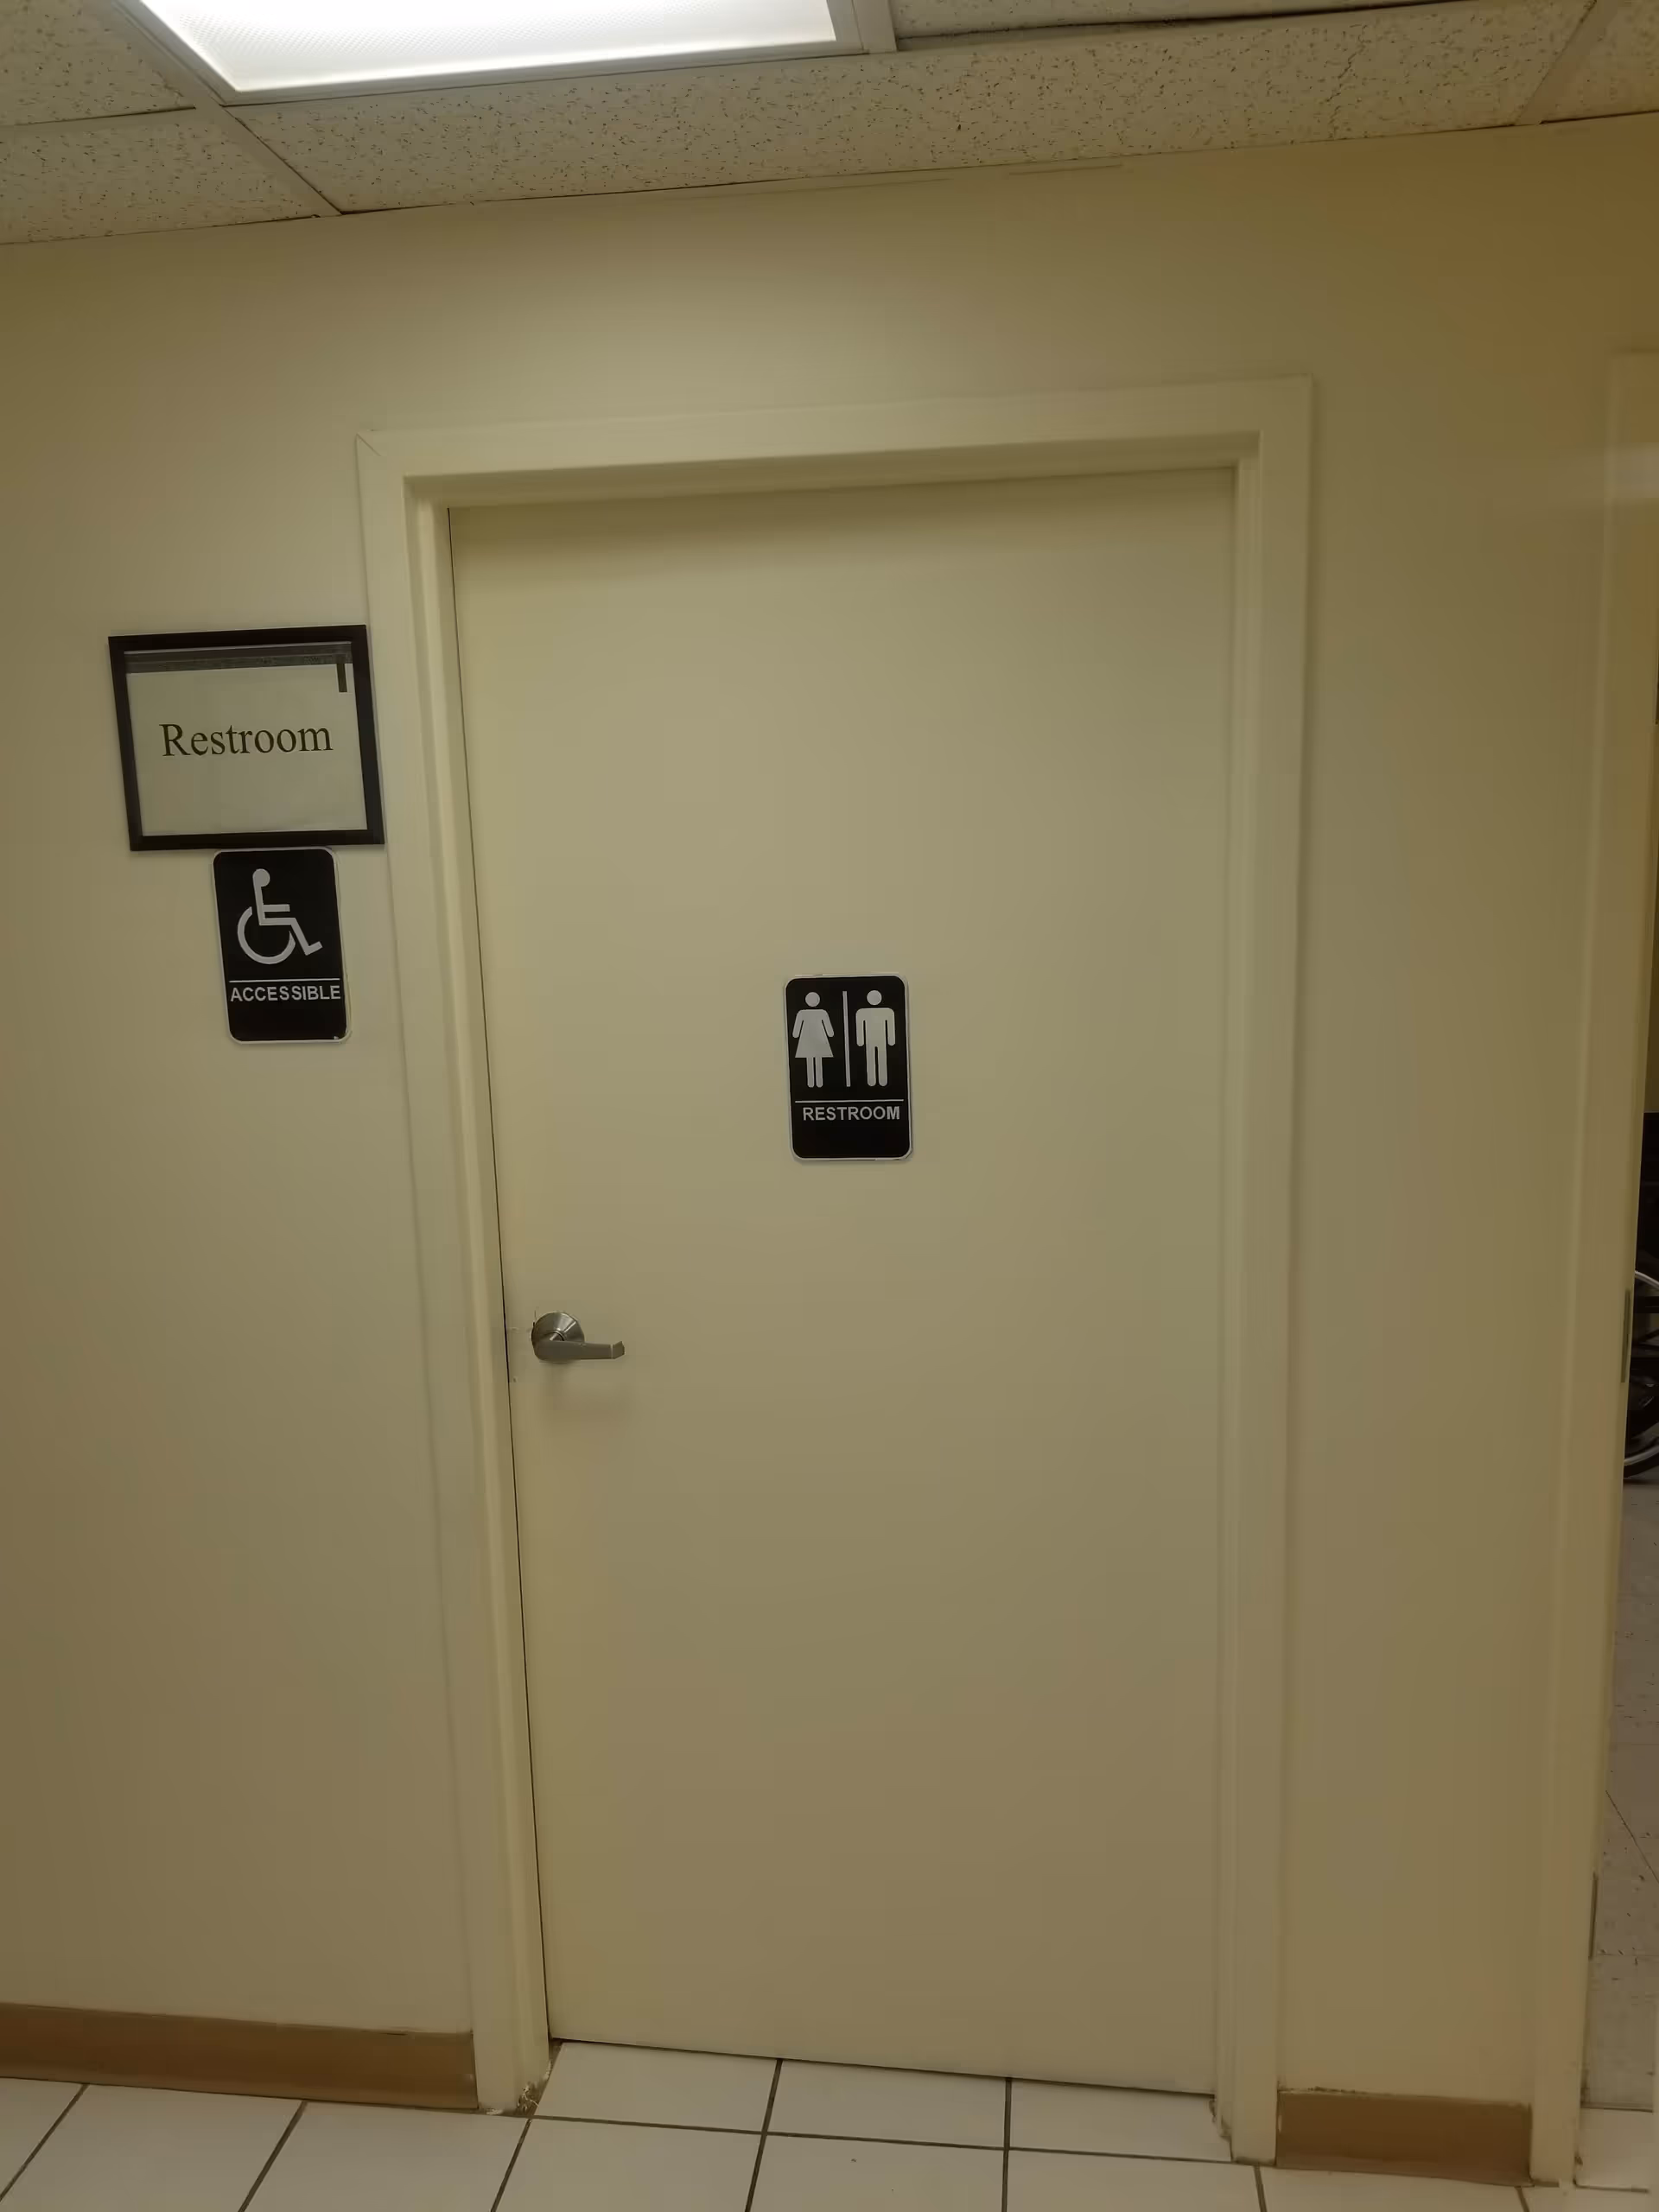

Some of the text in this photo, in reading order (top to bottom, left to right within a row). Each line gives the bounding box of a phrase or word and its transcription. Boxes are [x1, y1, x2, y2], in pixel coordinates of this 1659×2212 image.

[159, 723, 334, 757] Restroom
[230, 985, 341, 1002] ACCESSIBLE
[803, 1106, 900, 1121] RESTROOM
